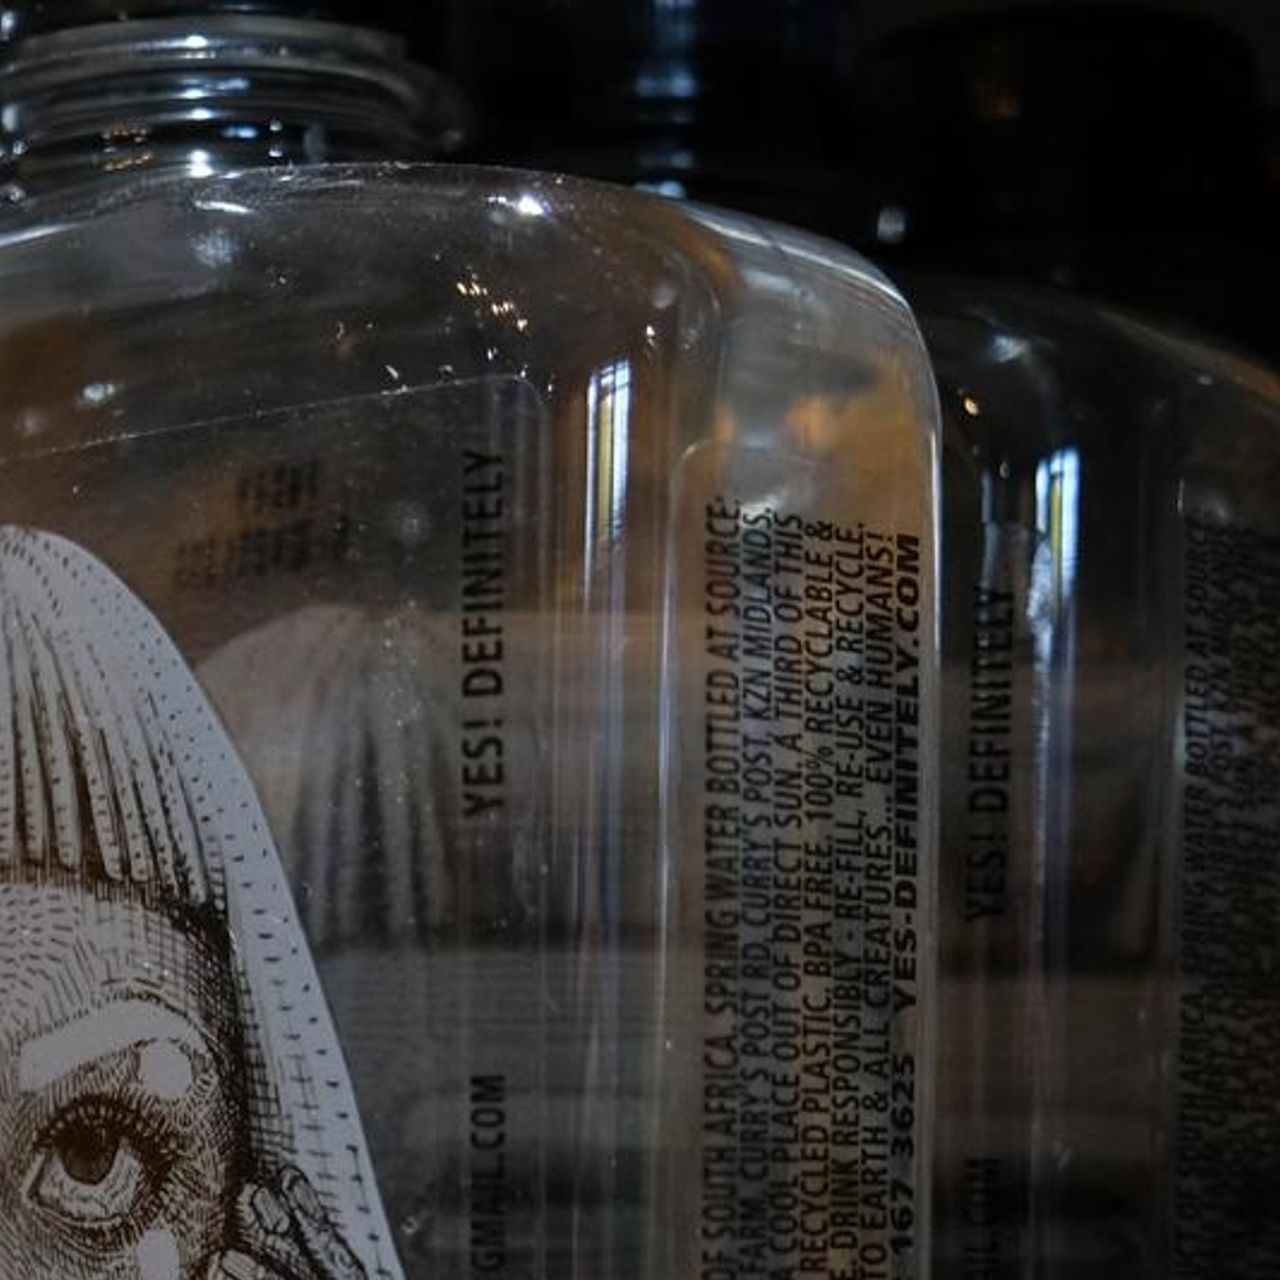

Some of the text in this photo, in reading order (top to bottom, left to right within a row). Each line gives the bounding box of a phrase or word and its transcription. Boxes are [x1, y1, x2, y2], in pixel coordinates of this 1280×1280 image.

[775, 509, 801, 576] THIS
[806, 520, 834, 541] &
[742, 508, 772, 659] MIDLANDS.
[775, 583, 801, 623] OF
[836, 522, 864, 654] RECYCLE.
[866, 532, 894, 690] HUMANS!
[461, 450, 504, 818] YES! DEFINITELY
[705, 626, 739, 662] AT
[774, 635, 801, 719] THIRD
[805, 551, 833, 735] RECYCLABLE
[837, 665, 864, 685] &
[705, 671, 740, 794] BOTTLED
[742, 670, 771, 720] KZN
[774, 733, 802, 752] A
[802, 746, 834, 822] 100%
[836, 695, 864, 798] RE-USE
[865, 700, 893, 785] EVEN
[893, 534, 920, 1015] YES-DEFINITELY.COM
[965, 585, 1013, 921] YES! DEFINITELY
[774, 761, 801, 828] SUN.
[705, 805, 739, 902] WATER
[741, 814, 772, 925] CURRY'S
[774, 837, 801, 943] DIRECT
[704, 910, 739, 1016] SPRING
[773, 954, 801, 991] OF
[803, 922, 832, 977] BPA
[740, 990, 771, 1056] POST
[772, 1005, 800, 1061] OUT
[802, 988, 831, 1113] PLASTIC.
[831, 948, 861, 1146] RESPONSIBLY
[862, 1022, 890, 1078] ALL
[703, 1025, 739, 1136] AFRICA.
[739, 1069, 769, 1180] CURRY'S
[771, 1075, 799, 1162] PLACE
[860, 1092, 889, 1112] &
[891, 1053, 915, 1157] 3625
[701, 1146, 737, 1239] SOUTH
[770, 1177, 799, 1254] COOL
[800, 1125, 828, 1272] RECYCLED
[829, 1159, 858, 1249] DRINK
[860, 1127, 888, 1230] EARTH
[890, 1180, 914, 1255] 167
